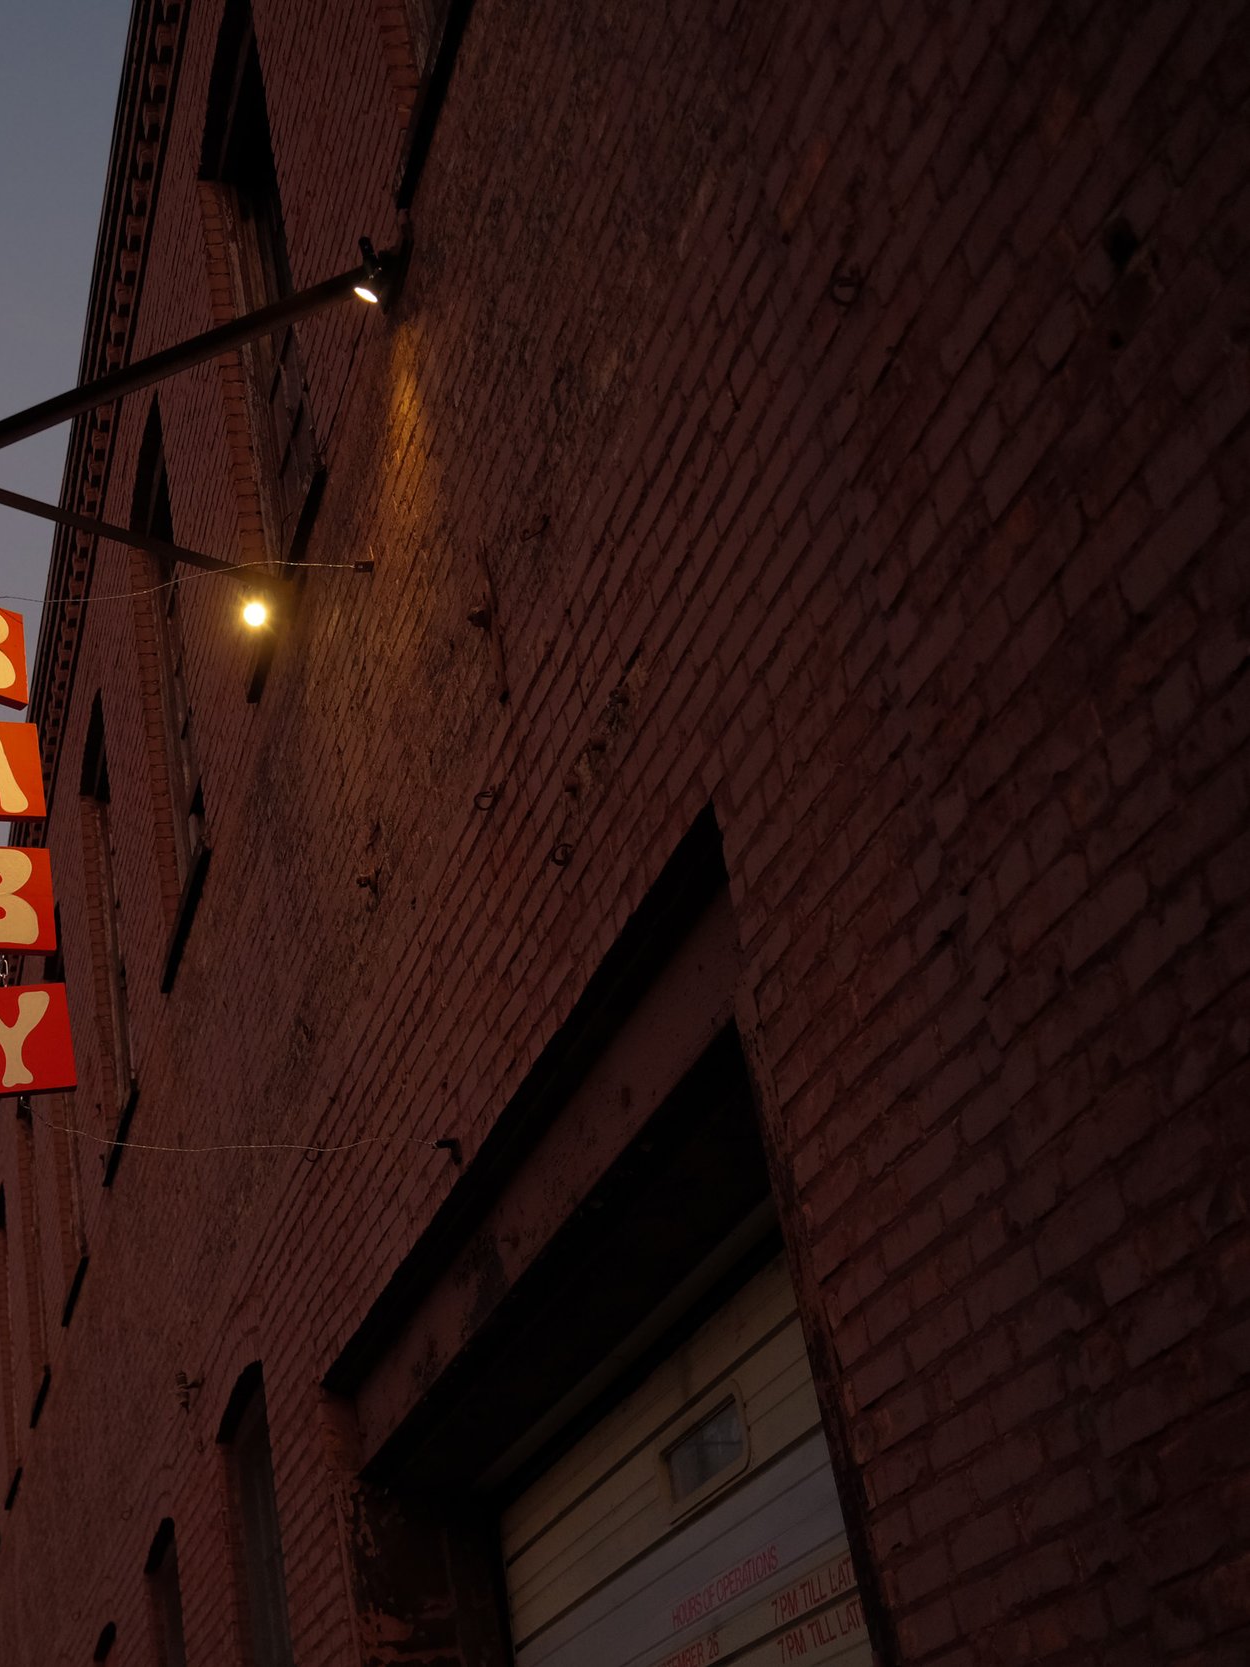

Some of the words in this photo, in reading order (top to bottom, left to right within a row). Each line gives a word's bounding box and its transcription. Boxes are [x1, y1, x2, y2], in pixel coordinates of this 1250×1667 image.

[671, 1592, 702, 1631] HOURS
[702, 1583, 715, 1611] OF
[716, 1544, 779, 1601] OPERATIONS
[799, 1574, 828, 1609] TILL
[828, 1556, 856, 1594] LAT
[807, 1614, 837, 1649] TILL
